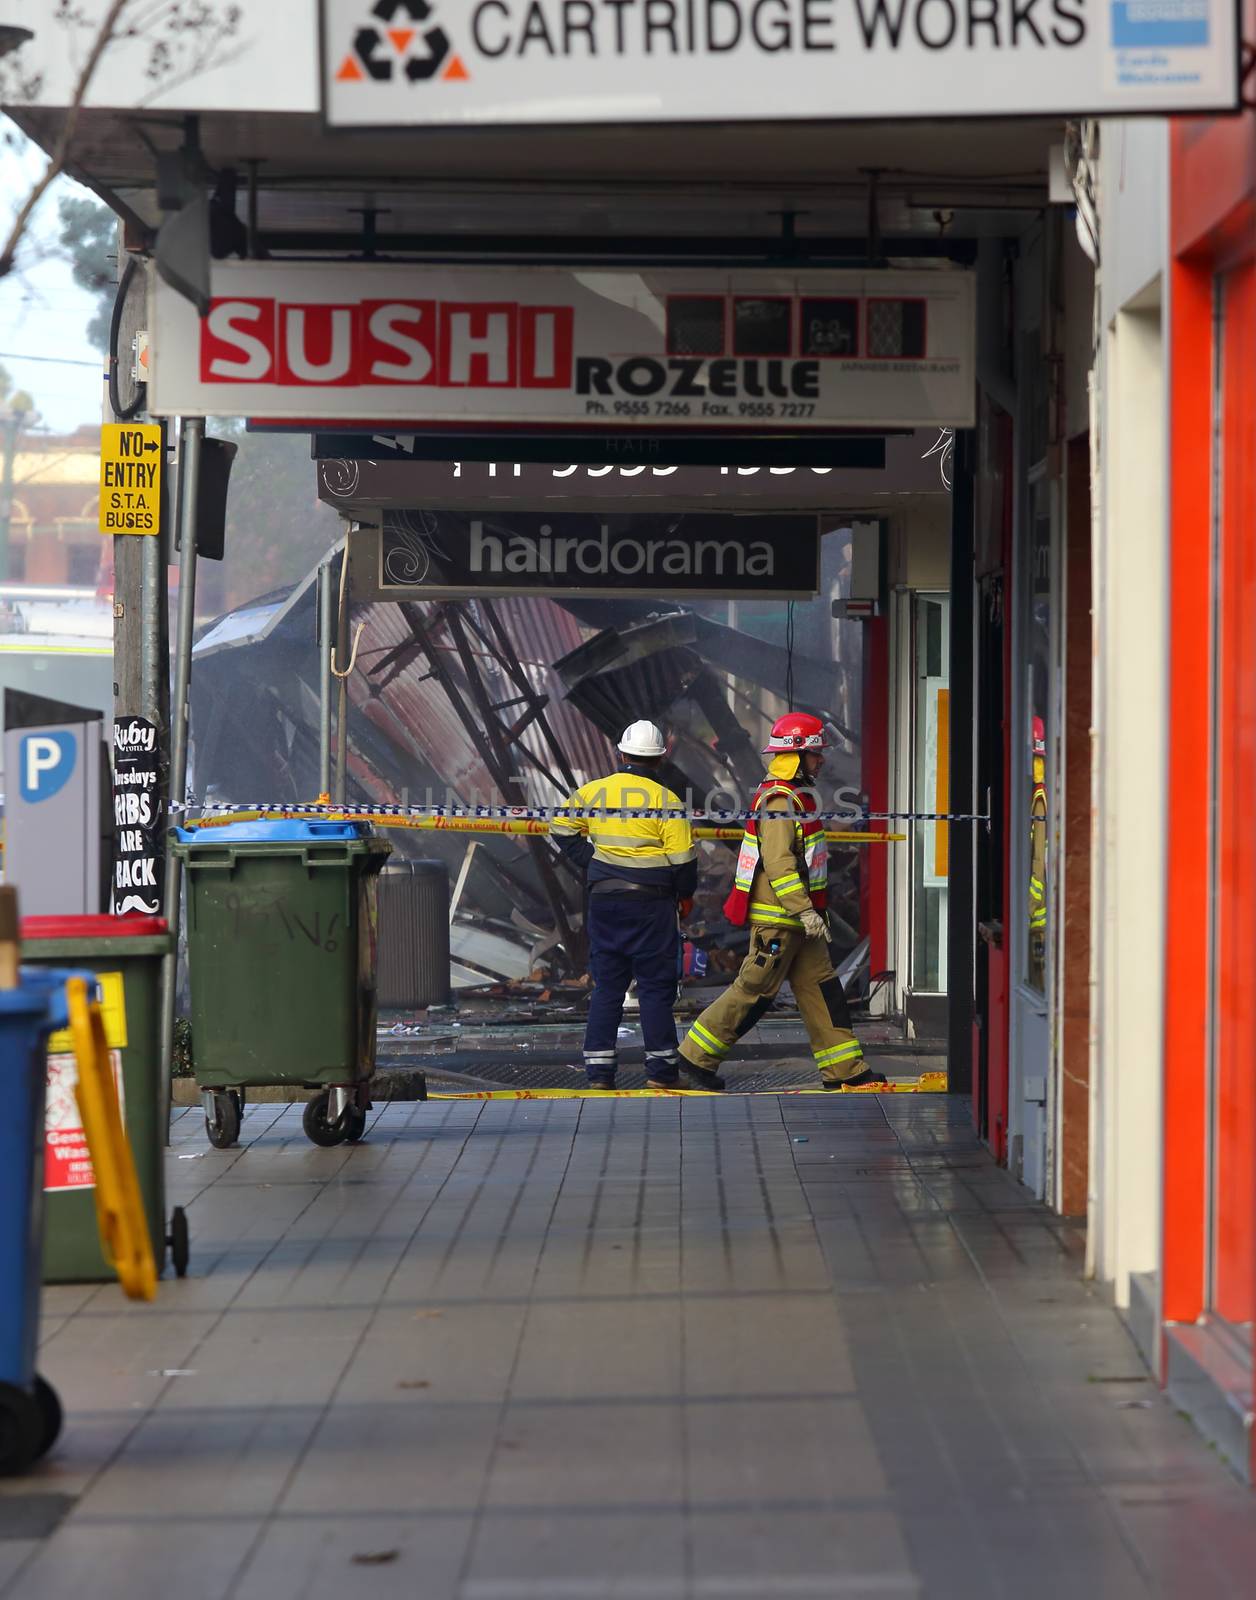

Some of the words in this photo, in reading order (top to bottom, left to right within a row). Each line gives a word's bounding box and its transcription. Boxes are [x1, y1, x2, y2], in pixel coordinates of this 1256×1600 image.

[470, 0, 835, 57] CARTRIDGE
[854, 0, 1086, 49] WORKS
[205, 301, 555, 383] SUSHI
[575, 357, 820, 398] ROZELLE
[586, 401, 608, 415] Ph.
[614, 401, 649, 415] 9555
[655, 402, 690, 416] 7266
[702, 402, 732, 416] Fax.
[738, 403, 774, 417] 9555
[780, 403, 816, 417] 7277
[120, 432, 144, 457] NO
[105, 462, 157, 488] ENTRY
[111, 493, 150, 509] S.T.A.
[106, 512, 153, 529] BUSES
[470, 521, 774, 575] hairdorama
[113, 721, 156, 752] Ruby
[27, 737, 62, 790] P
[115, 793, 151, 826] RIBS
[120, 830, 143, 852] ARE
[116, 858, 157, 888] BACK
